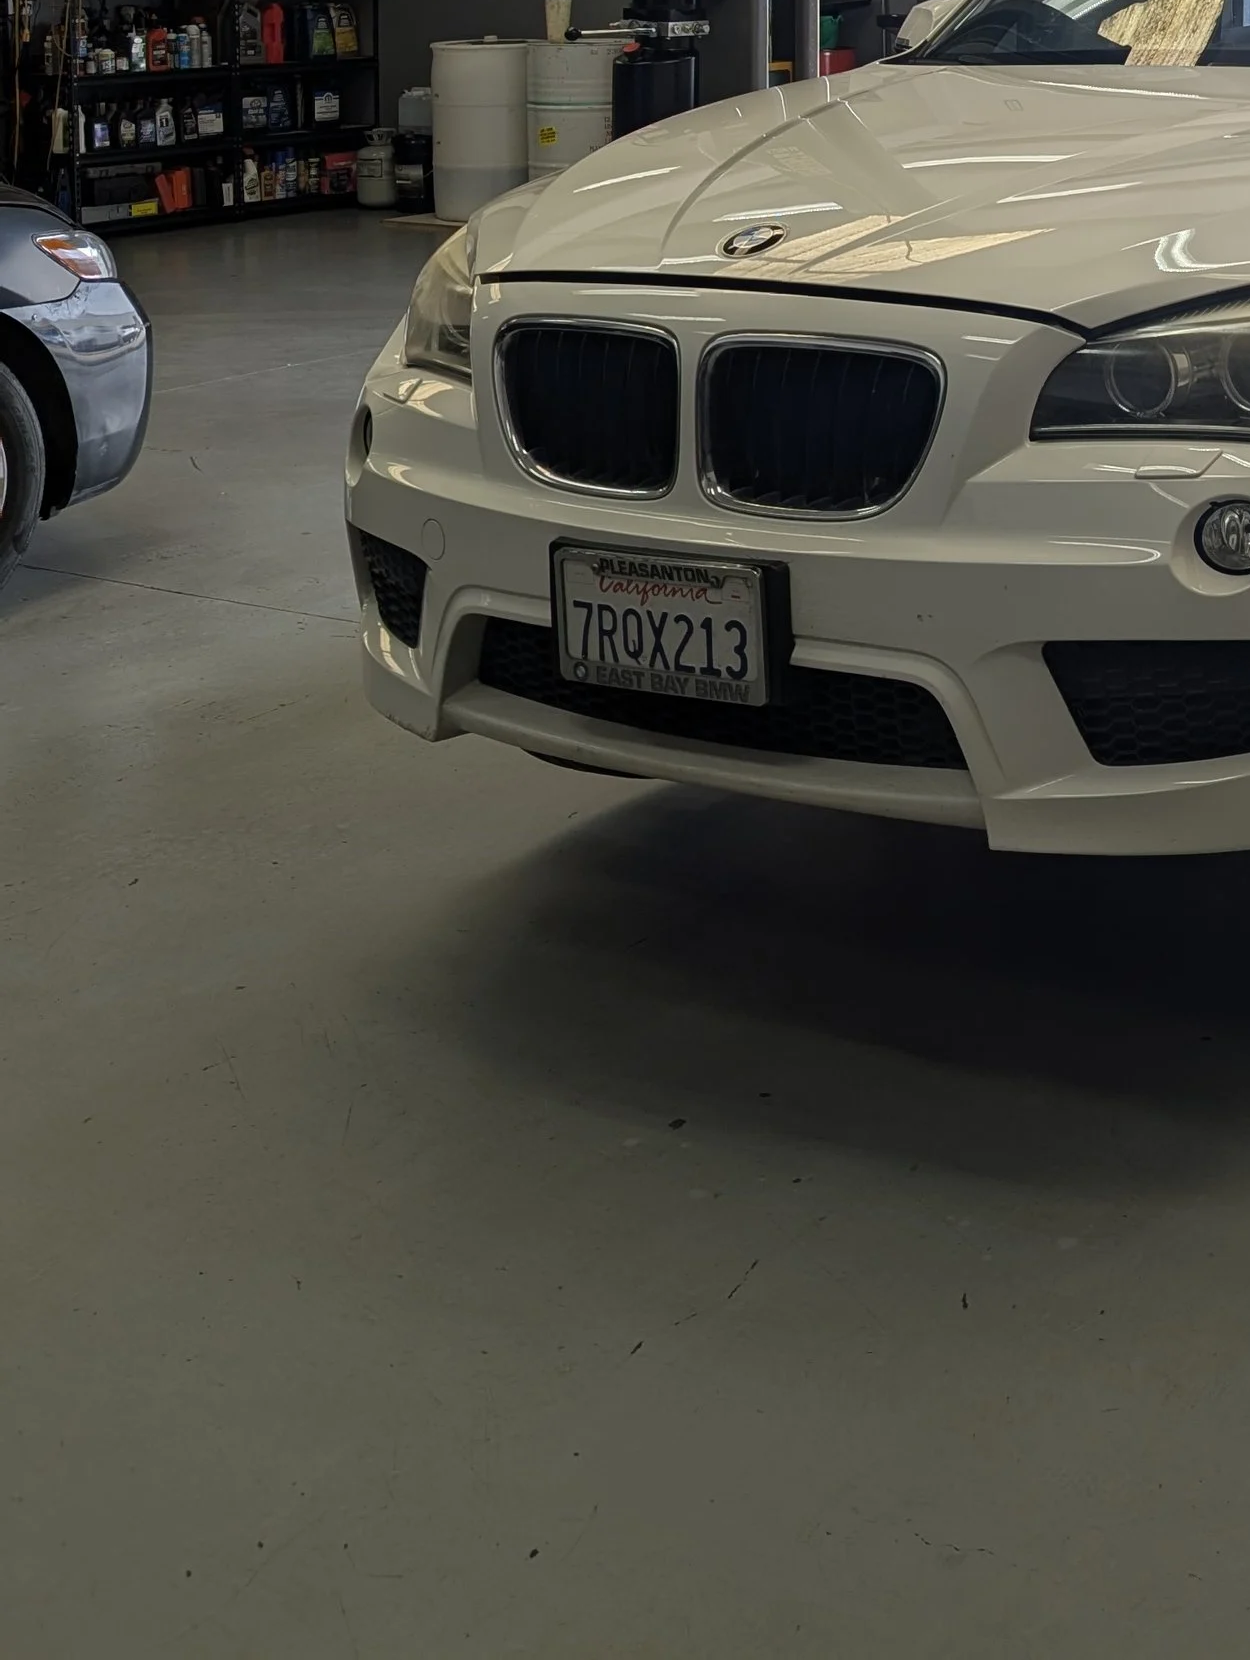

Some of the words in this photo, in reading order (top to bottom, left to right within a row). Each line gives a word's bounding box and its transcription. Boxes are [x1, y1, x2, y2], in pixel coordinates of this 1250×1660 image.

[600, 558, 709, 584] PLEASANTON
[599, 575, 723, 607] California
[573, 600, 748, 680] 7RQX213
[596, 665, 645, 688] EAST
[651, 671, 690, 695] BAY
[695, 680, 751, 703] BMW
